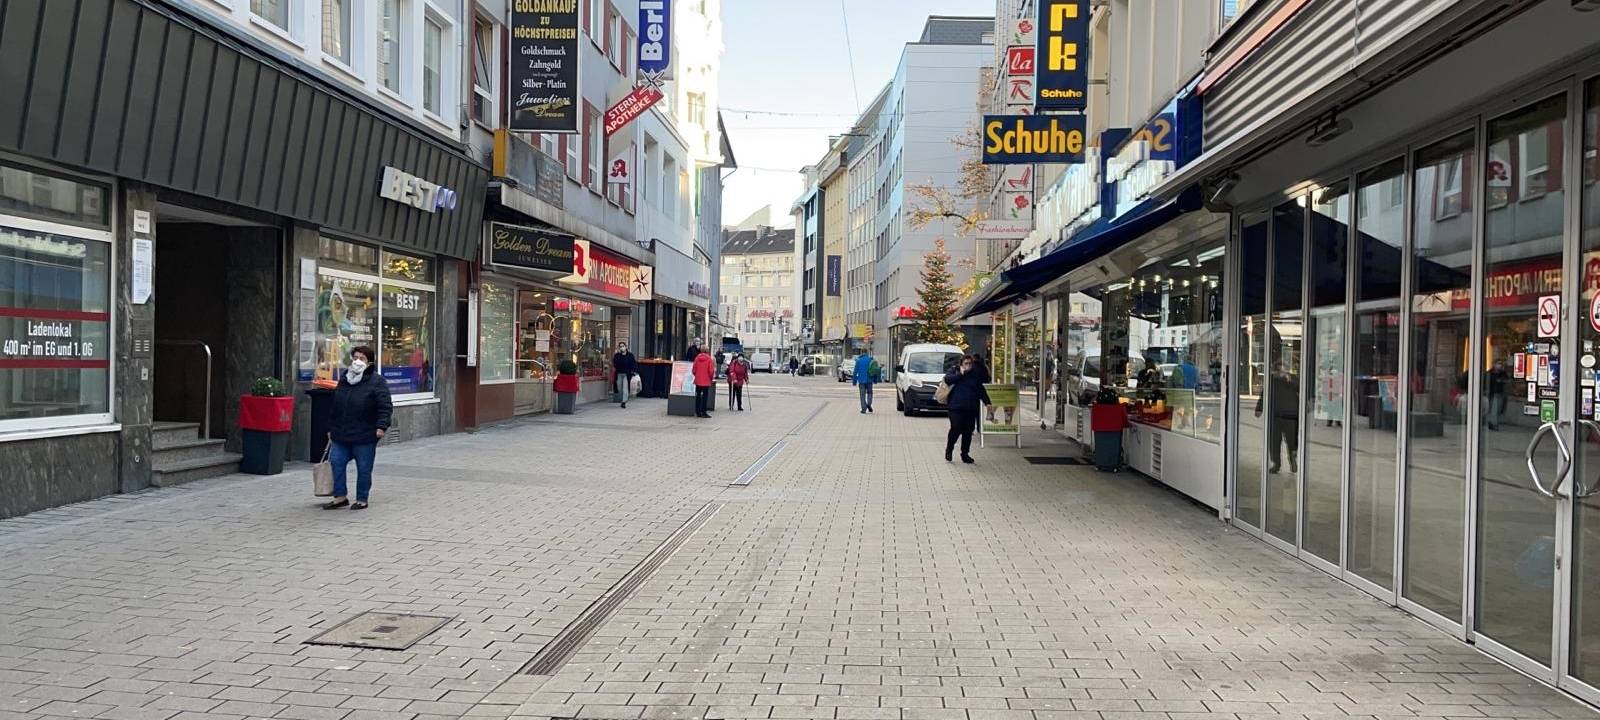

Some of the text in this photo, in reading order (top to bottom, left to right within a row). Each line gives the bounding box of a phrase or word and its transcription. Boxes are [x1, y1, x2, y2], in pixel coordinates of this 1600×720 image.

[515, 0, 576, 13] GOLDANKAUF
[514, 25, 576, 39] HÖCHSTPREISEN
[521, 45, 566, 56] Goldschmuck
[529, 59, 561, 72] Zahngold
[522, 78, 567, 89] Silber Platin
[1041, 88, 1082, 98] Schuhe
[605, 95, 651, 134] APOTHEKE
[608, 94, 637, 120] STERN
[986, 119, 1083, 154] Schuhe
[493, 230, 572, 259] Golden Dream
[599, 260, 630, 289] APOTHEKE
[396, 293, 420, 310] BEST
[28, 320, 72, 337] Ladenlokal
[3, 339, 19, 356] 400
[32, 341, 43, 356] im
[45, 341, 56, 356] EG
[57, 342, 72, 356] und
[74, 342, 81, 356] 1.
[82, 343, 93, 357] OG
